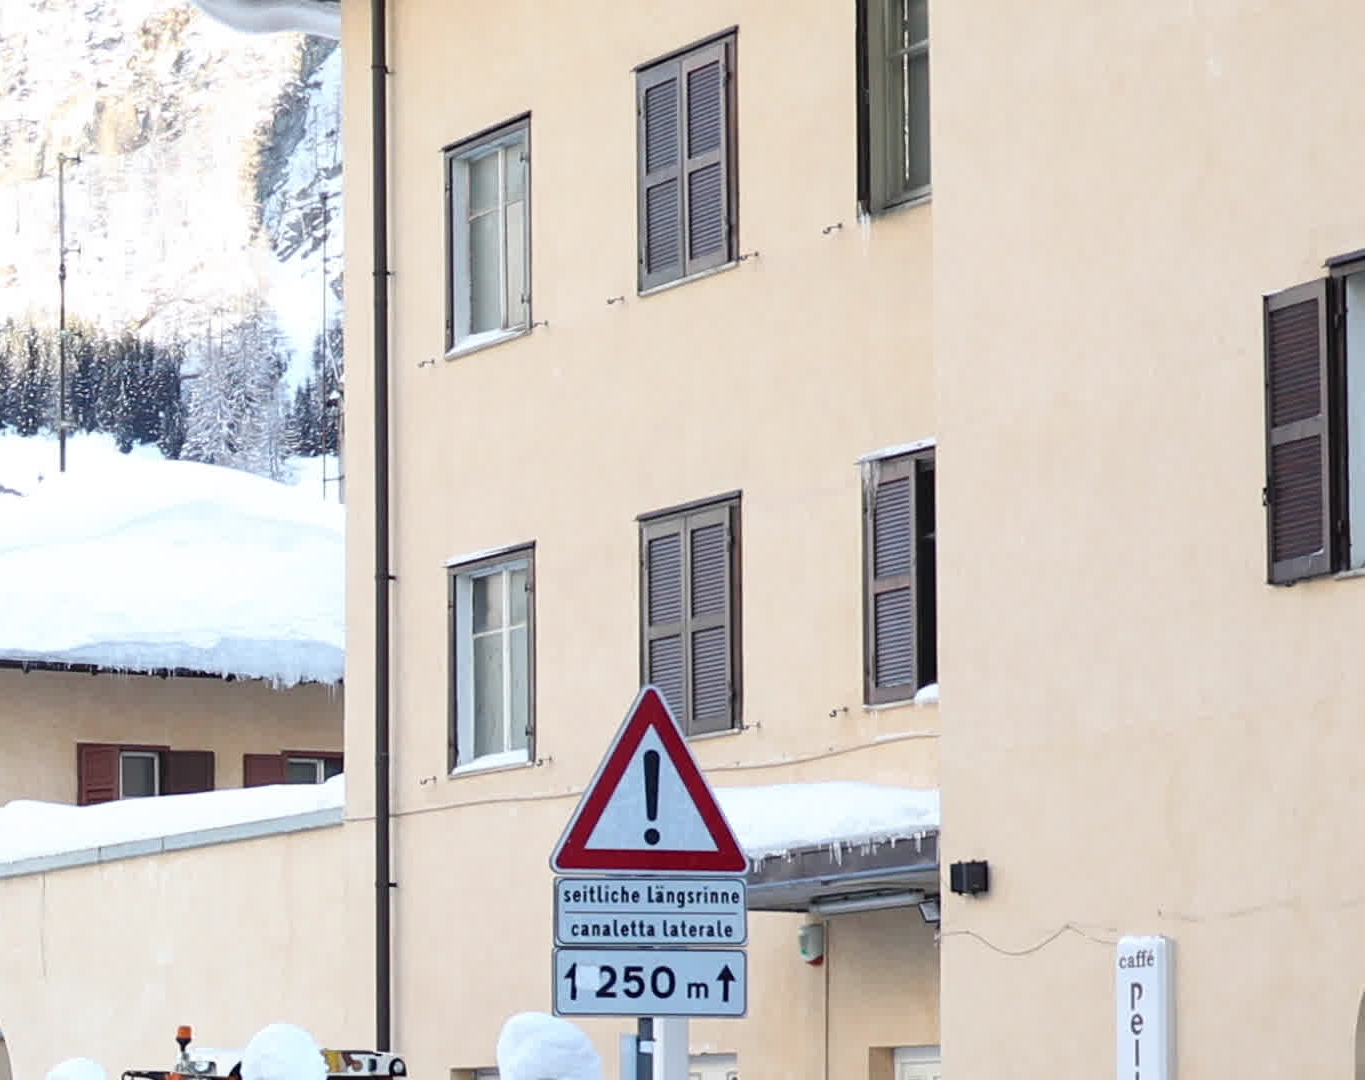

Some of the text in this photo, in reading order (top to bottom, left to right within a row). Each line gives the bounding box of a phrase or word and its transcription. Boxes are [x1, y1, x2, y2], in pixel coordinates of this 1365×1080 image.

[563, 885, 740, 908] seitliche Längsrinne
[571, 919, 734, 938] canaletta laterale
[595, 964, 709, 999] 250 m
